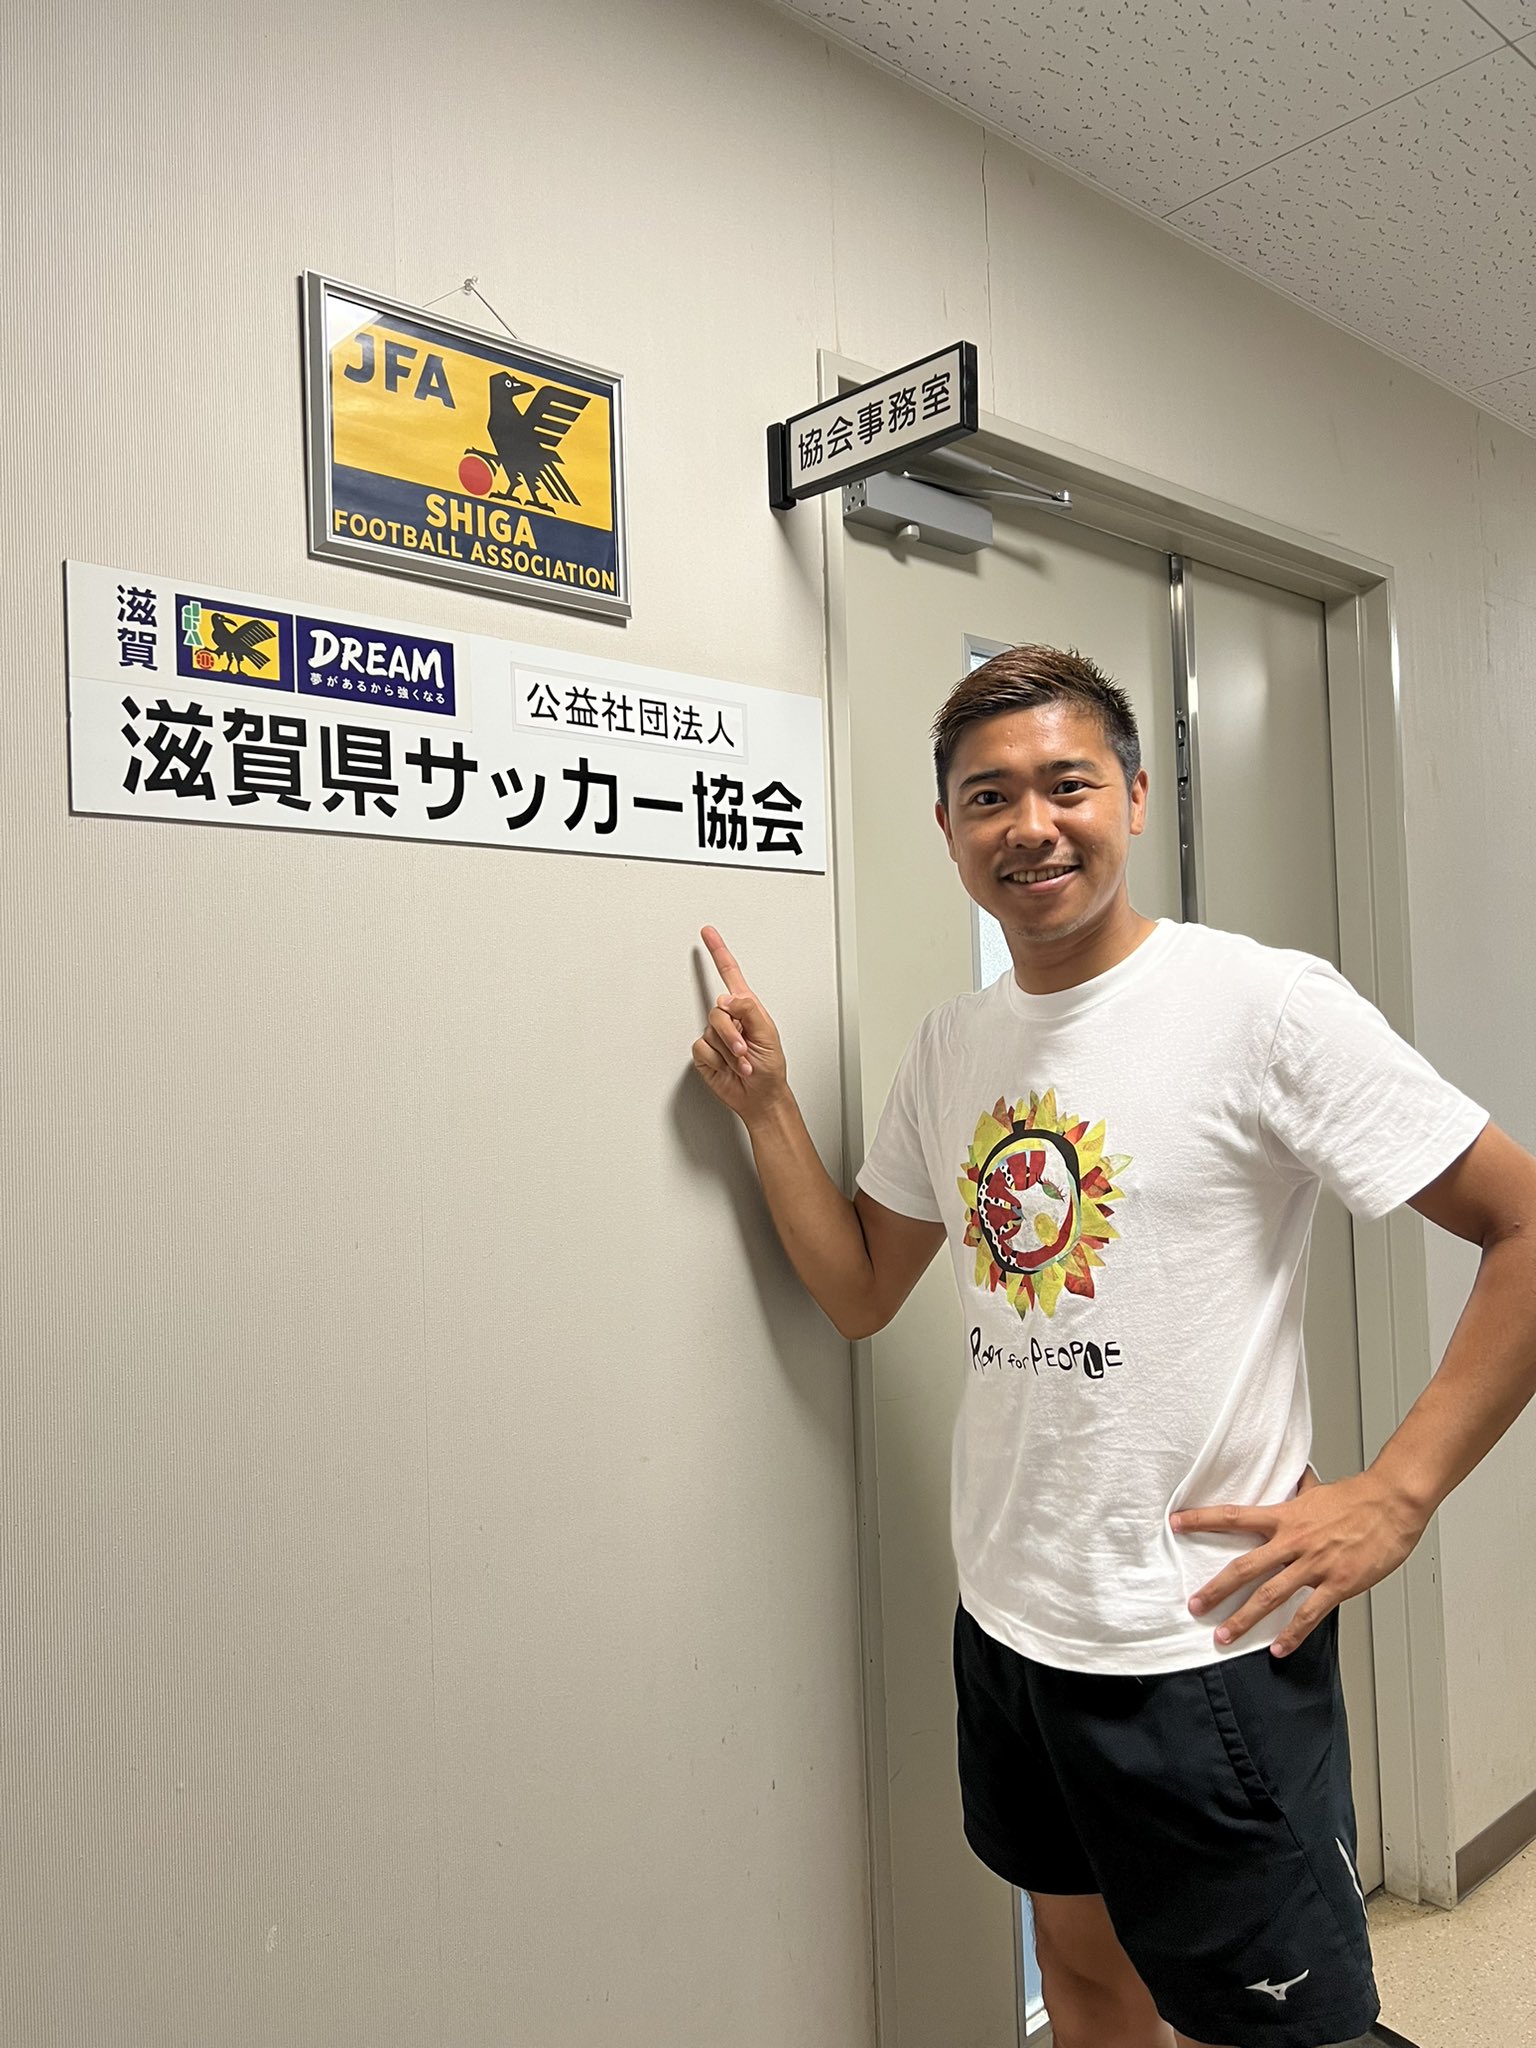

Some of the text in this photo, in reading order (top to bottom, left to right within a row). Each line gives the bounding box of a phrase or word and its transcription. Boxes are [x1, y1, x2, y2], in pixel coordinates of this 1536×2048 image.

[344, 333, 456, 409] JFA
[799, 372, 951, 471] 協会事務室
[334, 509, 615, 592] FOOTBALL ASSOCIATION
[425, 493, 537, 550] SHIGA
[116, 584, 158, 671] 滋賀
[308, 629, 444, 689] DREAM
[310, 672, 445, 705] 夢があるから強くなる
[527, 683, 735, 748] 公益社団法人
[121, 695, 803, 856] 滋賀県サッカー協会
[1030, 1337, 1123, 1379] PEOPLE
